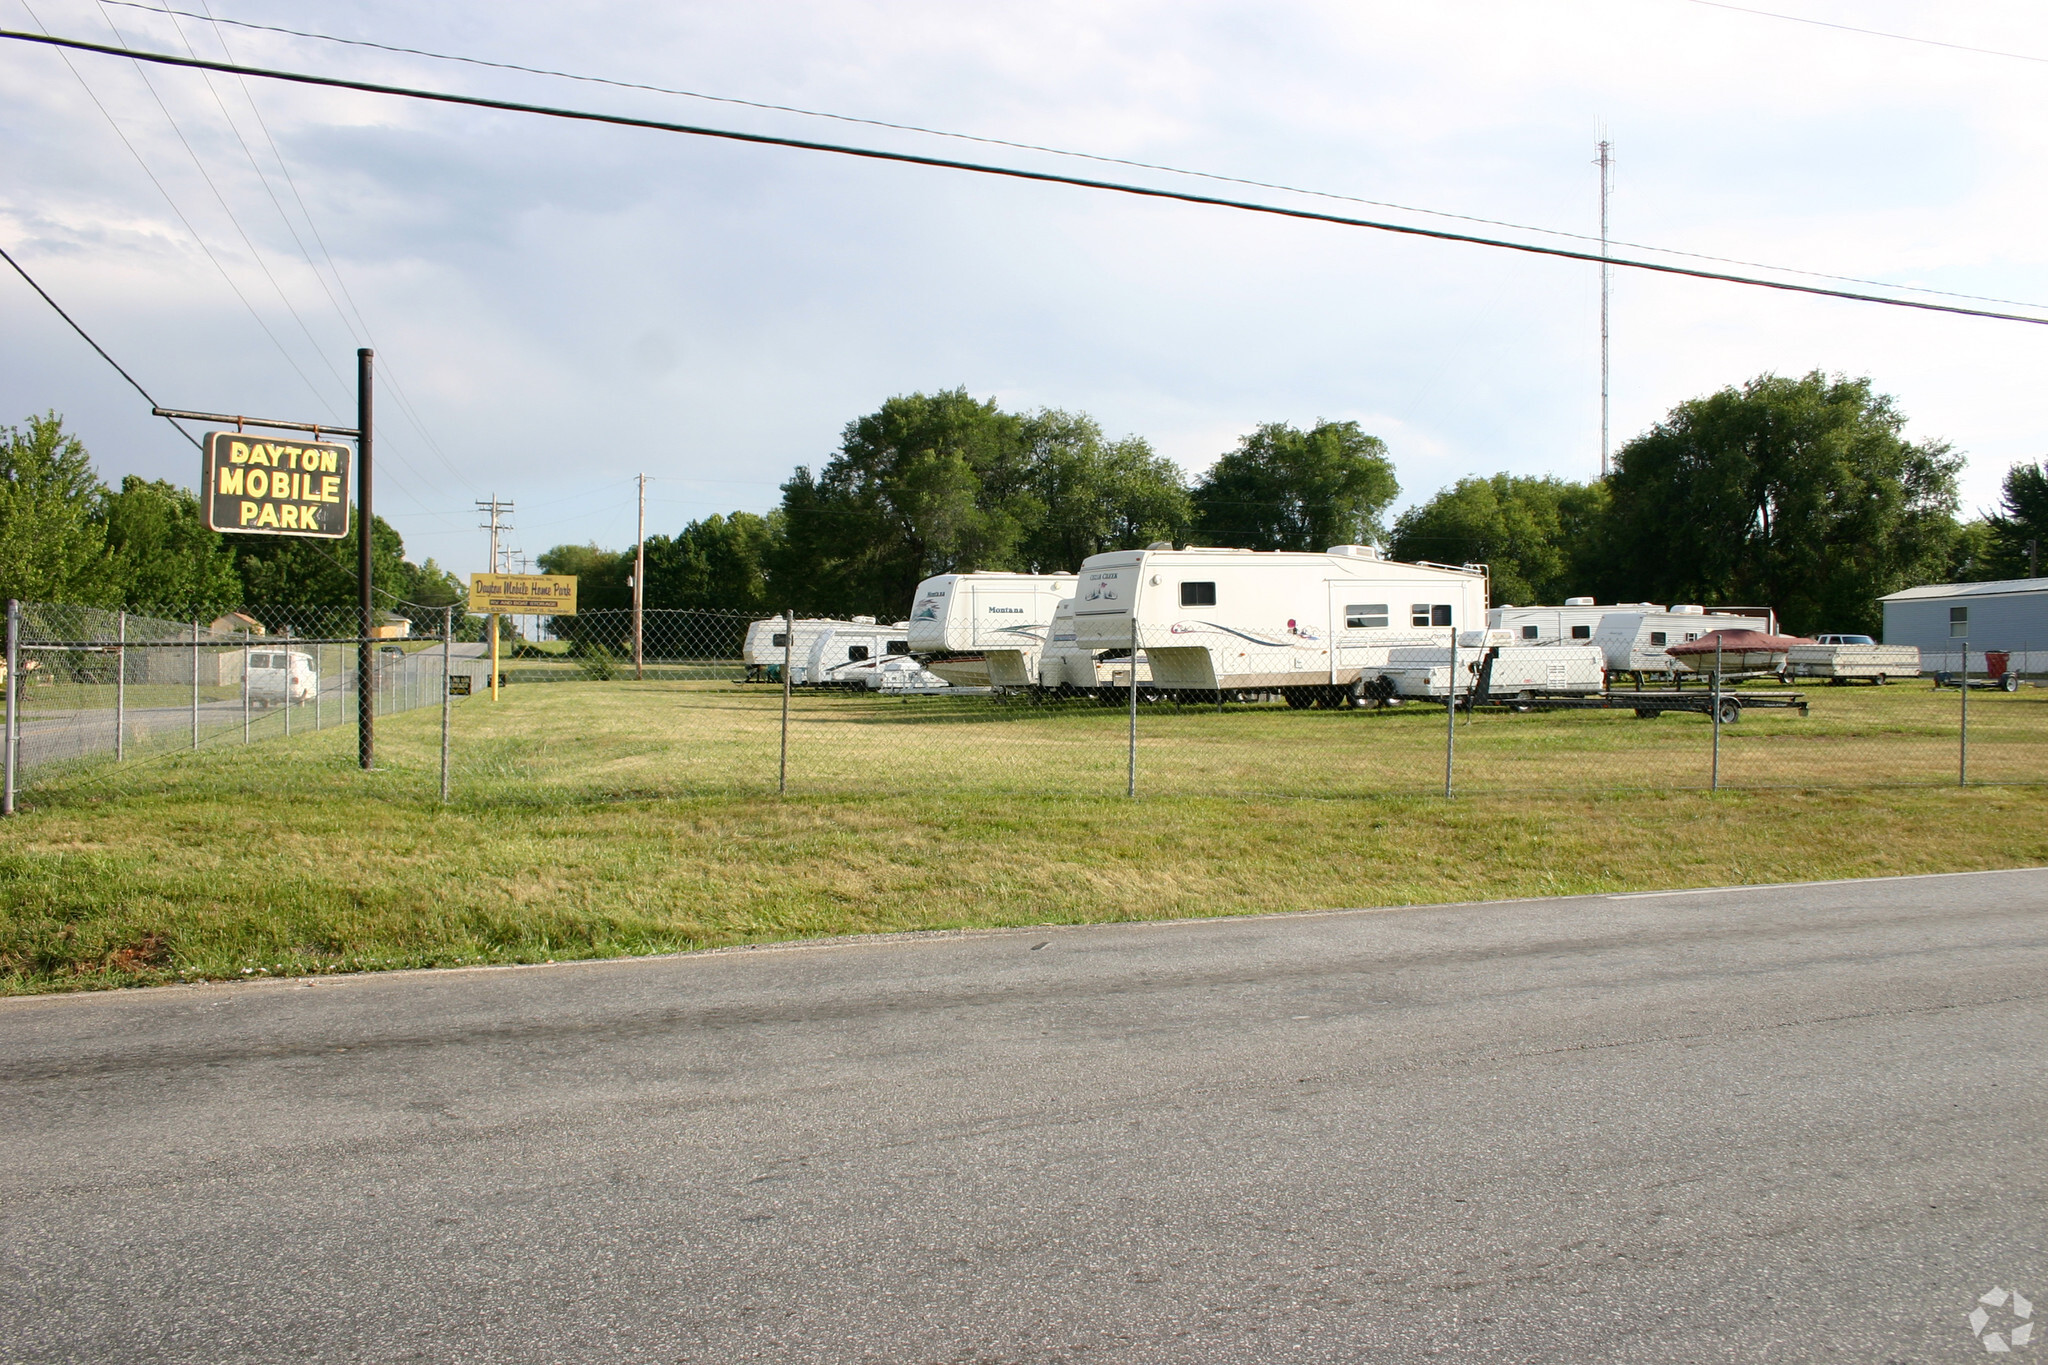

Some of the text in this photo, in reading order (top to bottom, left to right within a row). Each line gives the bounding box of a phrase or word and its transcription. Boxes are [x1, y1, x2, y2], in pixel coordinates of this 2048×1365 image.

[230, 441, 338, 473] DAYTON
[219, 466, 341, 503] MOBILE
[240, 501, 319, 530] PARK
[476, 579, 571, 596] Dayton Mobile Home Park
